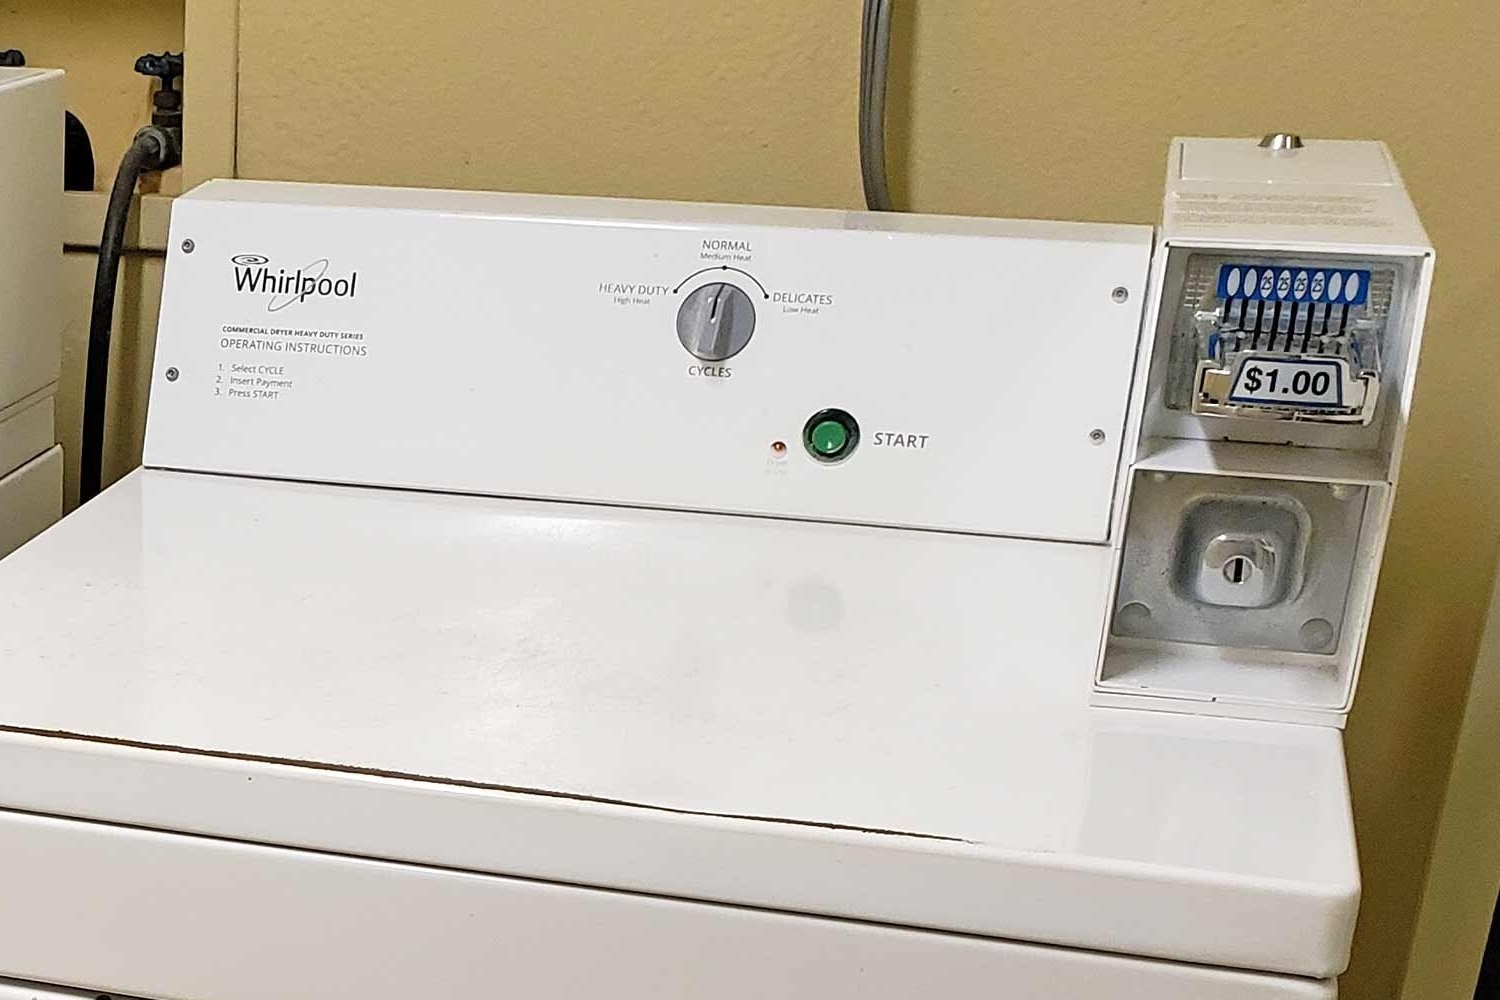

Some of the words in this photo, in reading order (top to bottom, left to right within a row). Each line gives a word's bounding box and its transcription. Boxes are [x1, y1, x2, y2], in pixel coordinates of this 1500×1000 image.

[702, 239, 752, 252] NORMAL
[700, 252, 731, 261] Medium
[733, 254, 751, 262] Heat
[234, 266, 357, 303] Whirlpool
[599, 283, 636, 294] HEAVY
[638, 285, 669, 296] DUTY
[1261, 276, 1273, 290] 25
[1278, 277, 1290, 291] 25
[1295, 277, 1307, 292] 25
[1312, 278, 1323, 293] 25
[772, 292, 833, 305] DELICATES
[222, 325, 268, 335] COMMERCIAL
[270, 328, 292, 336] DRYER
[294, 329, 318, 338] HEAVY
[319, 331, 339, 339] DUTY
[340, 332, 364, 340] SERIES
[220, 337, 282, 352] OPERATING
[285, 341, 368, 357] INSTRUCTIONS
[231, 363, 256, 373] Select
[258, 365, 285, 375] CYCLE
[688, 365, 732, 378] CYCLES
[230, 376, 254, 386] Insert
[256, 377, 293, 388] Payment
[1244, 366, 1330, 396] $1.00
[228, 388, 251, 398] Press
[252, 390, 279, 400] START
[873, 432, 929, 449] START
